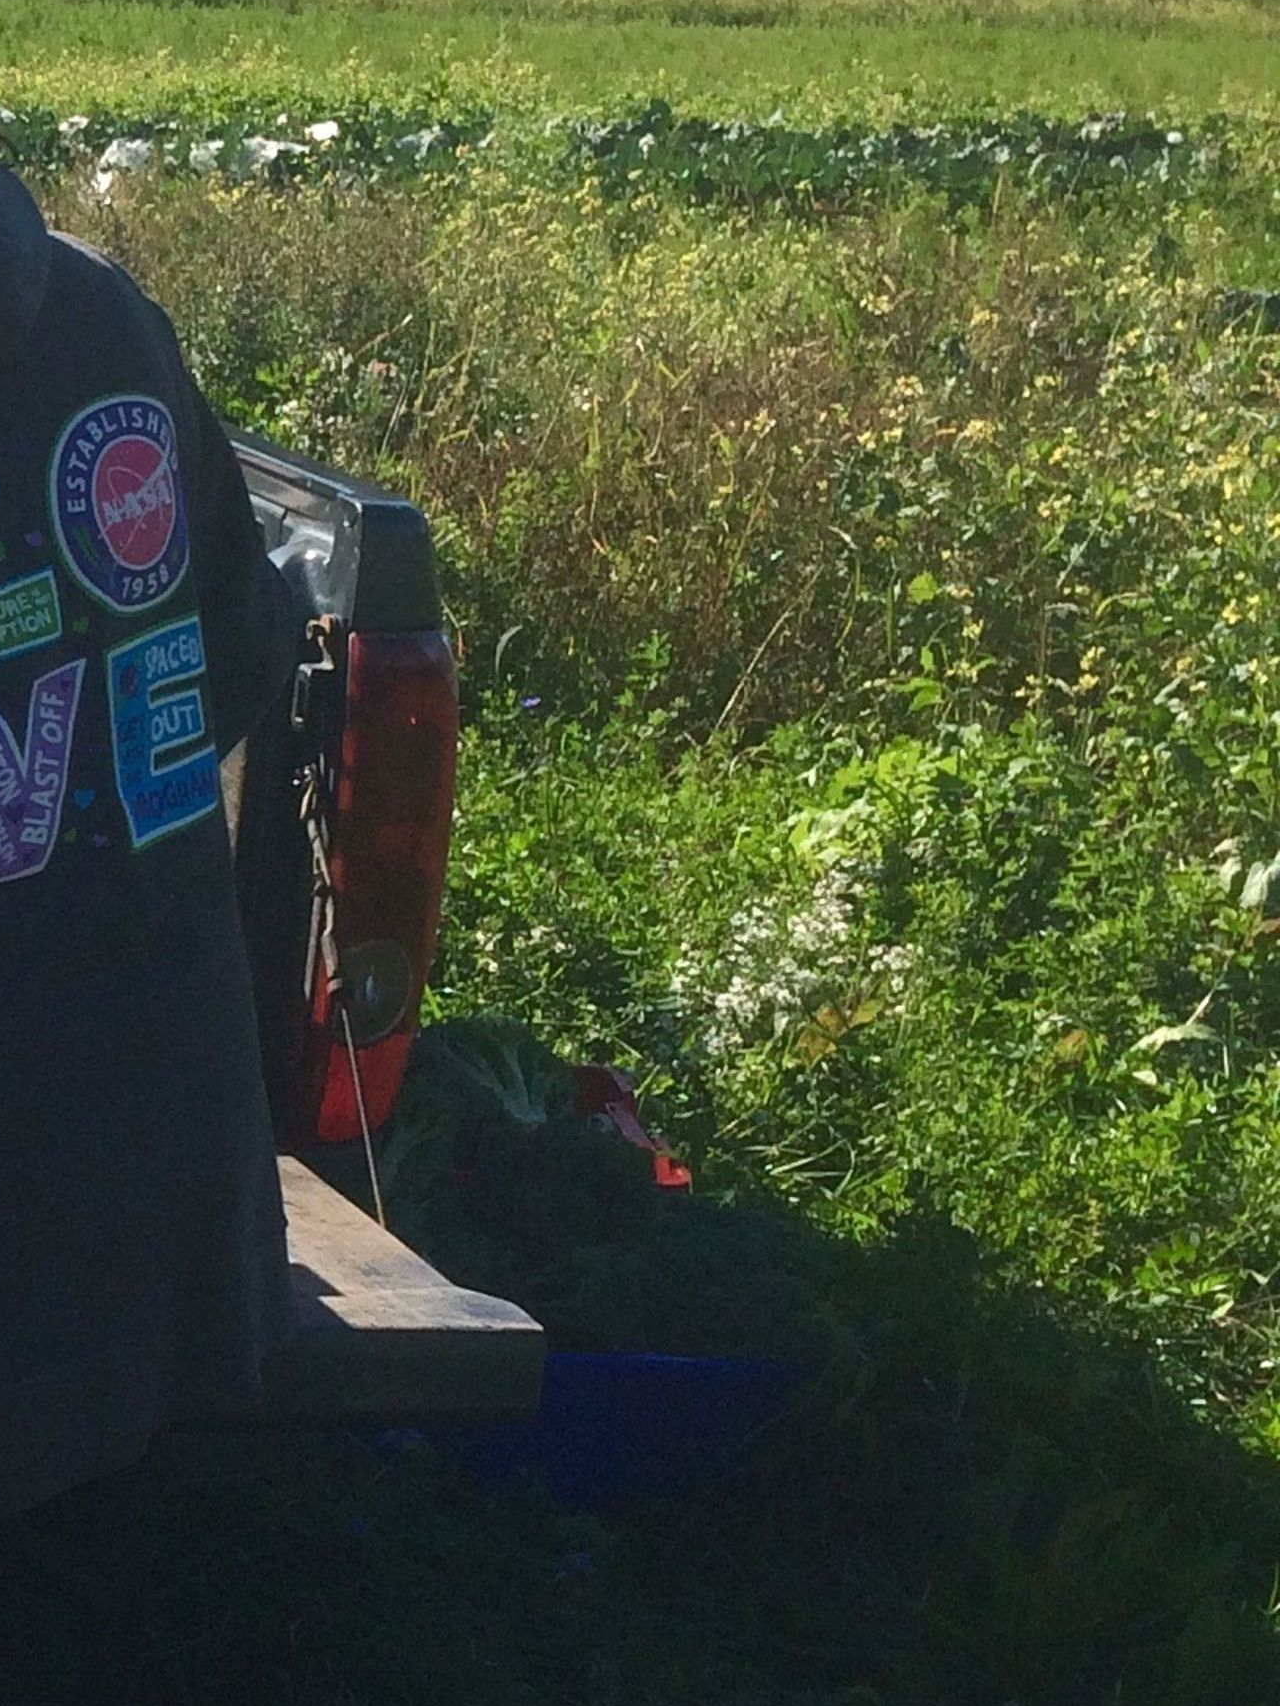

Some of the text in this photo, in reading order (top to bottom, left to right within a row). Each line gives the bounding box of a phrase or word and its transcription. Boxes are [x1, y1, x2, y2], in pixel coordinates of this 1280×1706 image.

[102, 479, 171, 525] NASA
[122, 564, 169, 599] 1958
[145, 634, 200, 679] SPACED
[151, 705, 196, 742] OUT
[20, 691, 65, 844] BLAST OFF
